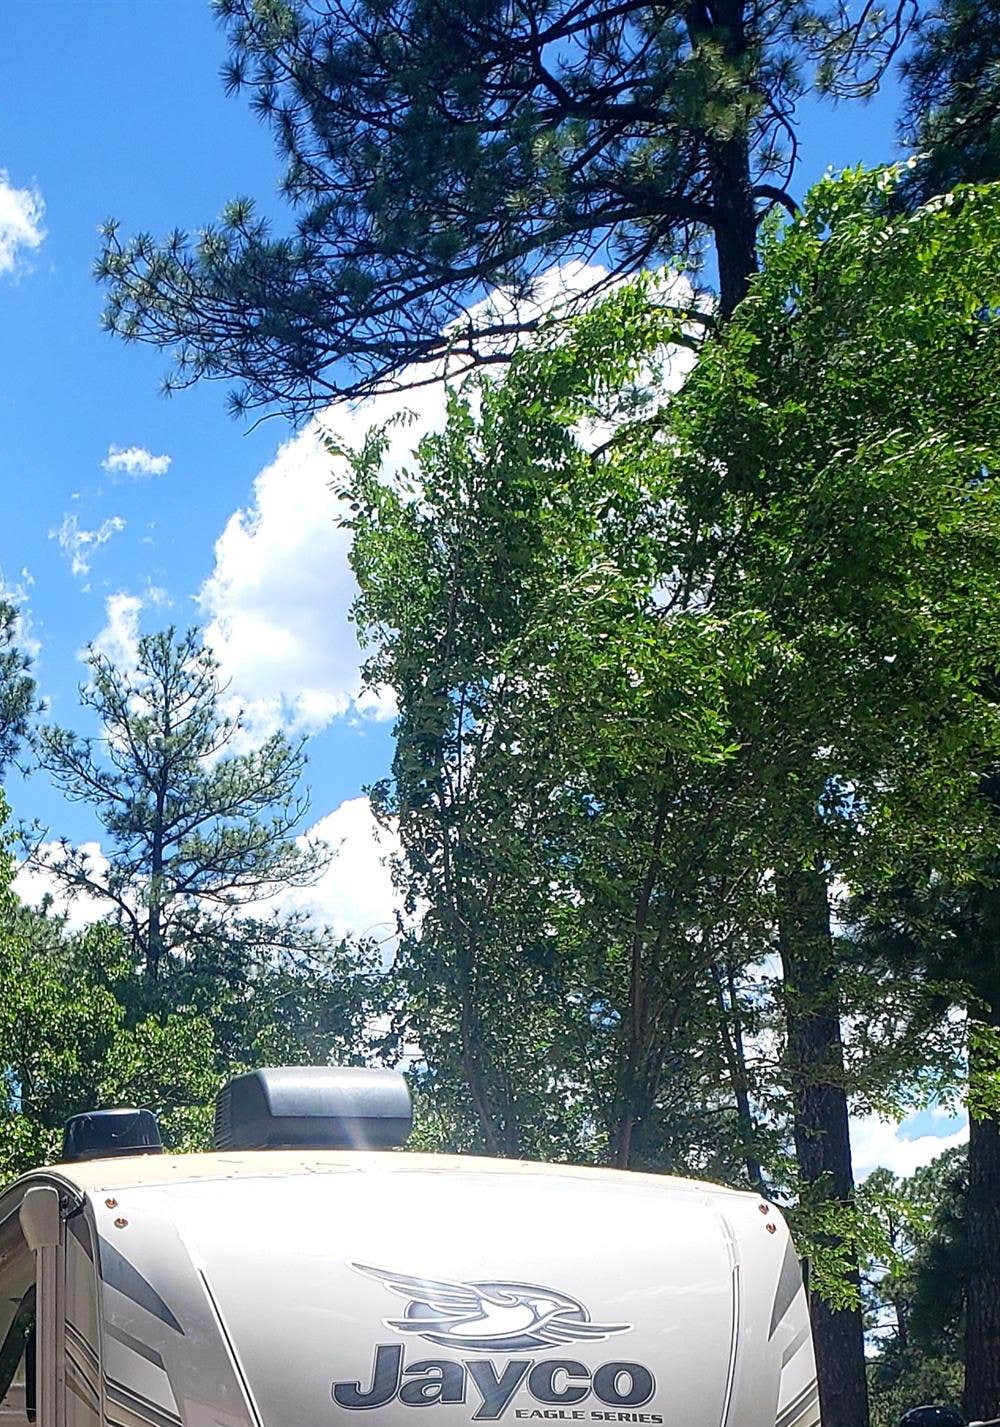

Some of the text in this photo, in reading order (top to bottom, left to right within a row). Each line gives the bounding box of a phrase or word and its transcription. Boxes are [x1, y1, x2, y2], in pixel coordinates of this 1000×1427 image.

[331, 1342, 656, 1420] Jayco
[515, 1409, 664, 1424] EAGLE SERIES
